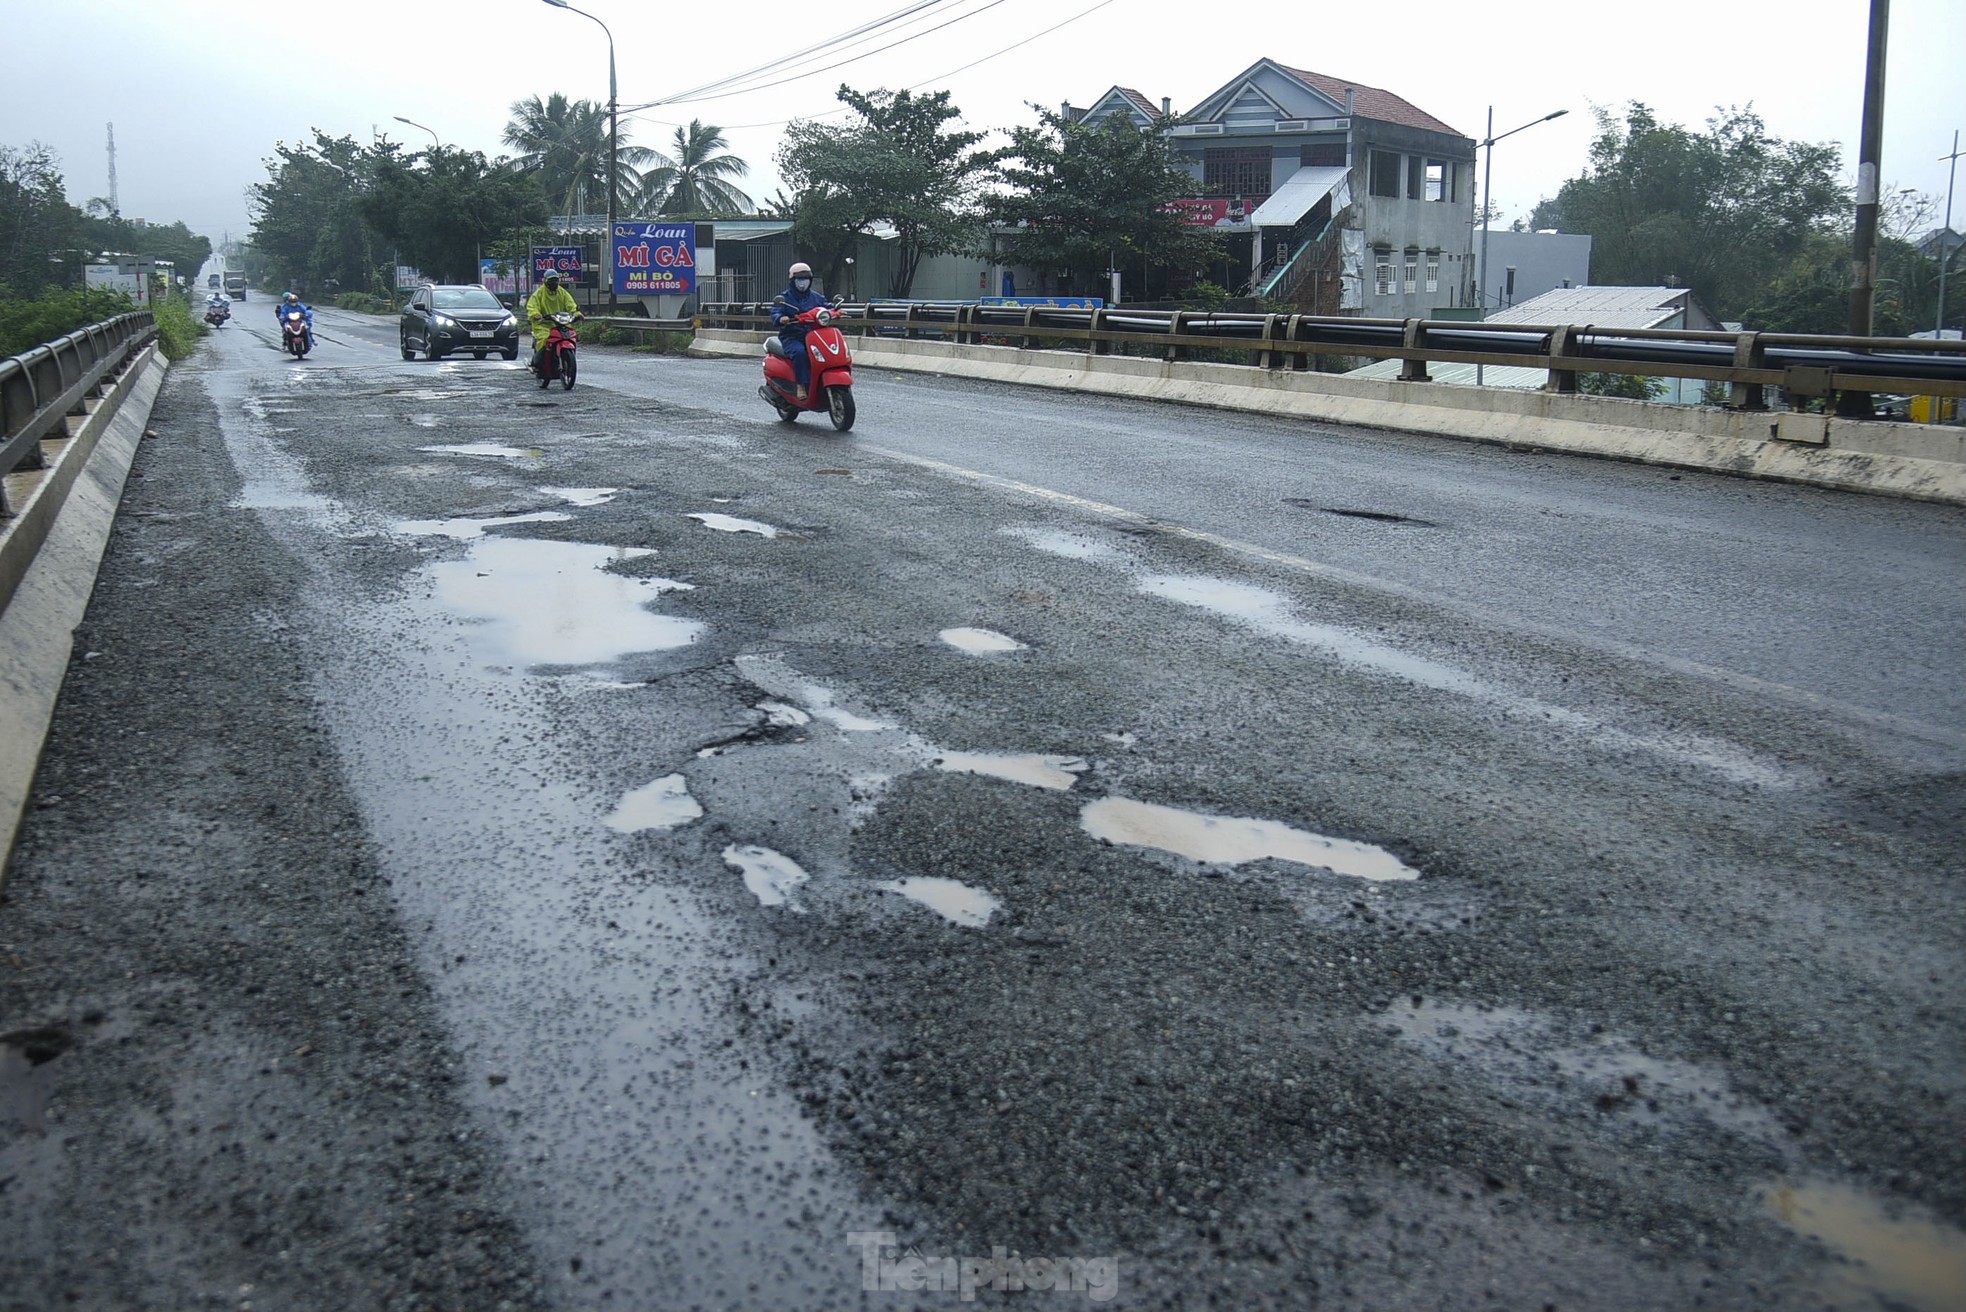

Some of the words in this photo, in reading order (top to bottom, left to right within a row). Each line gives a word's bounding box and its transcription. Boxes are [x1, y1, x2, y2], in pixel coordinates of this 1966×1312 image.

[640, 224, 688, 238] Loan
[548, 247, 577, 255] Loan
[618, 241, 650, 267] MÌ
[655, 241, 694, 267] GÀ
[536, 256, 555, 271] MÌ
[558, 256, 582, 270] GÀ
[629, 270, 648, 281] MÌ
[652, 270, 673, 281] BÒ
[626, 281, 648, 289] 0905
[650, 281, 681, 289] 611805
